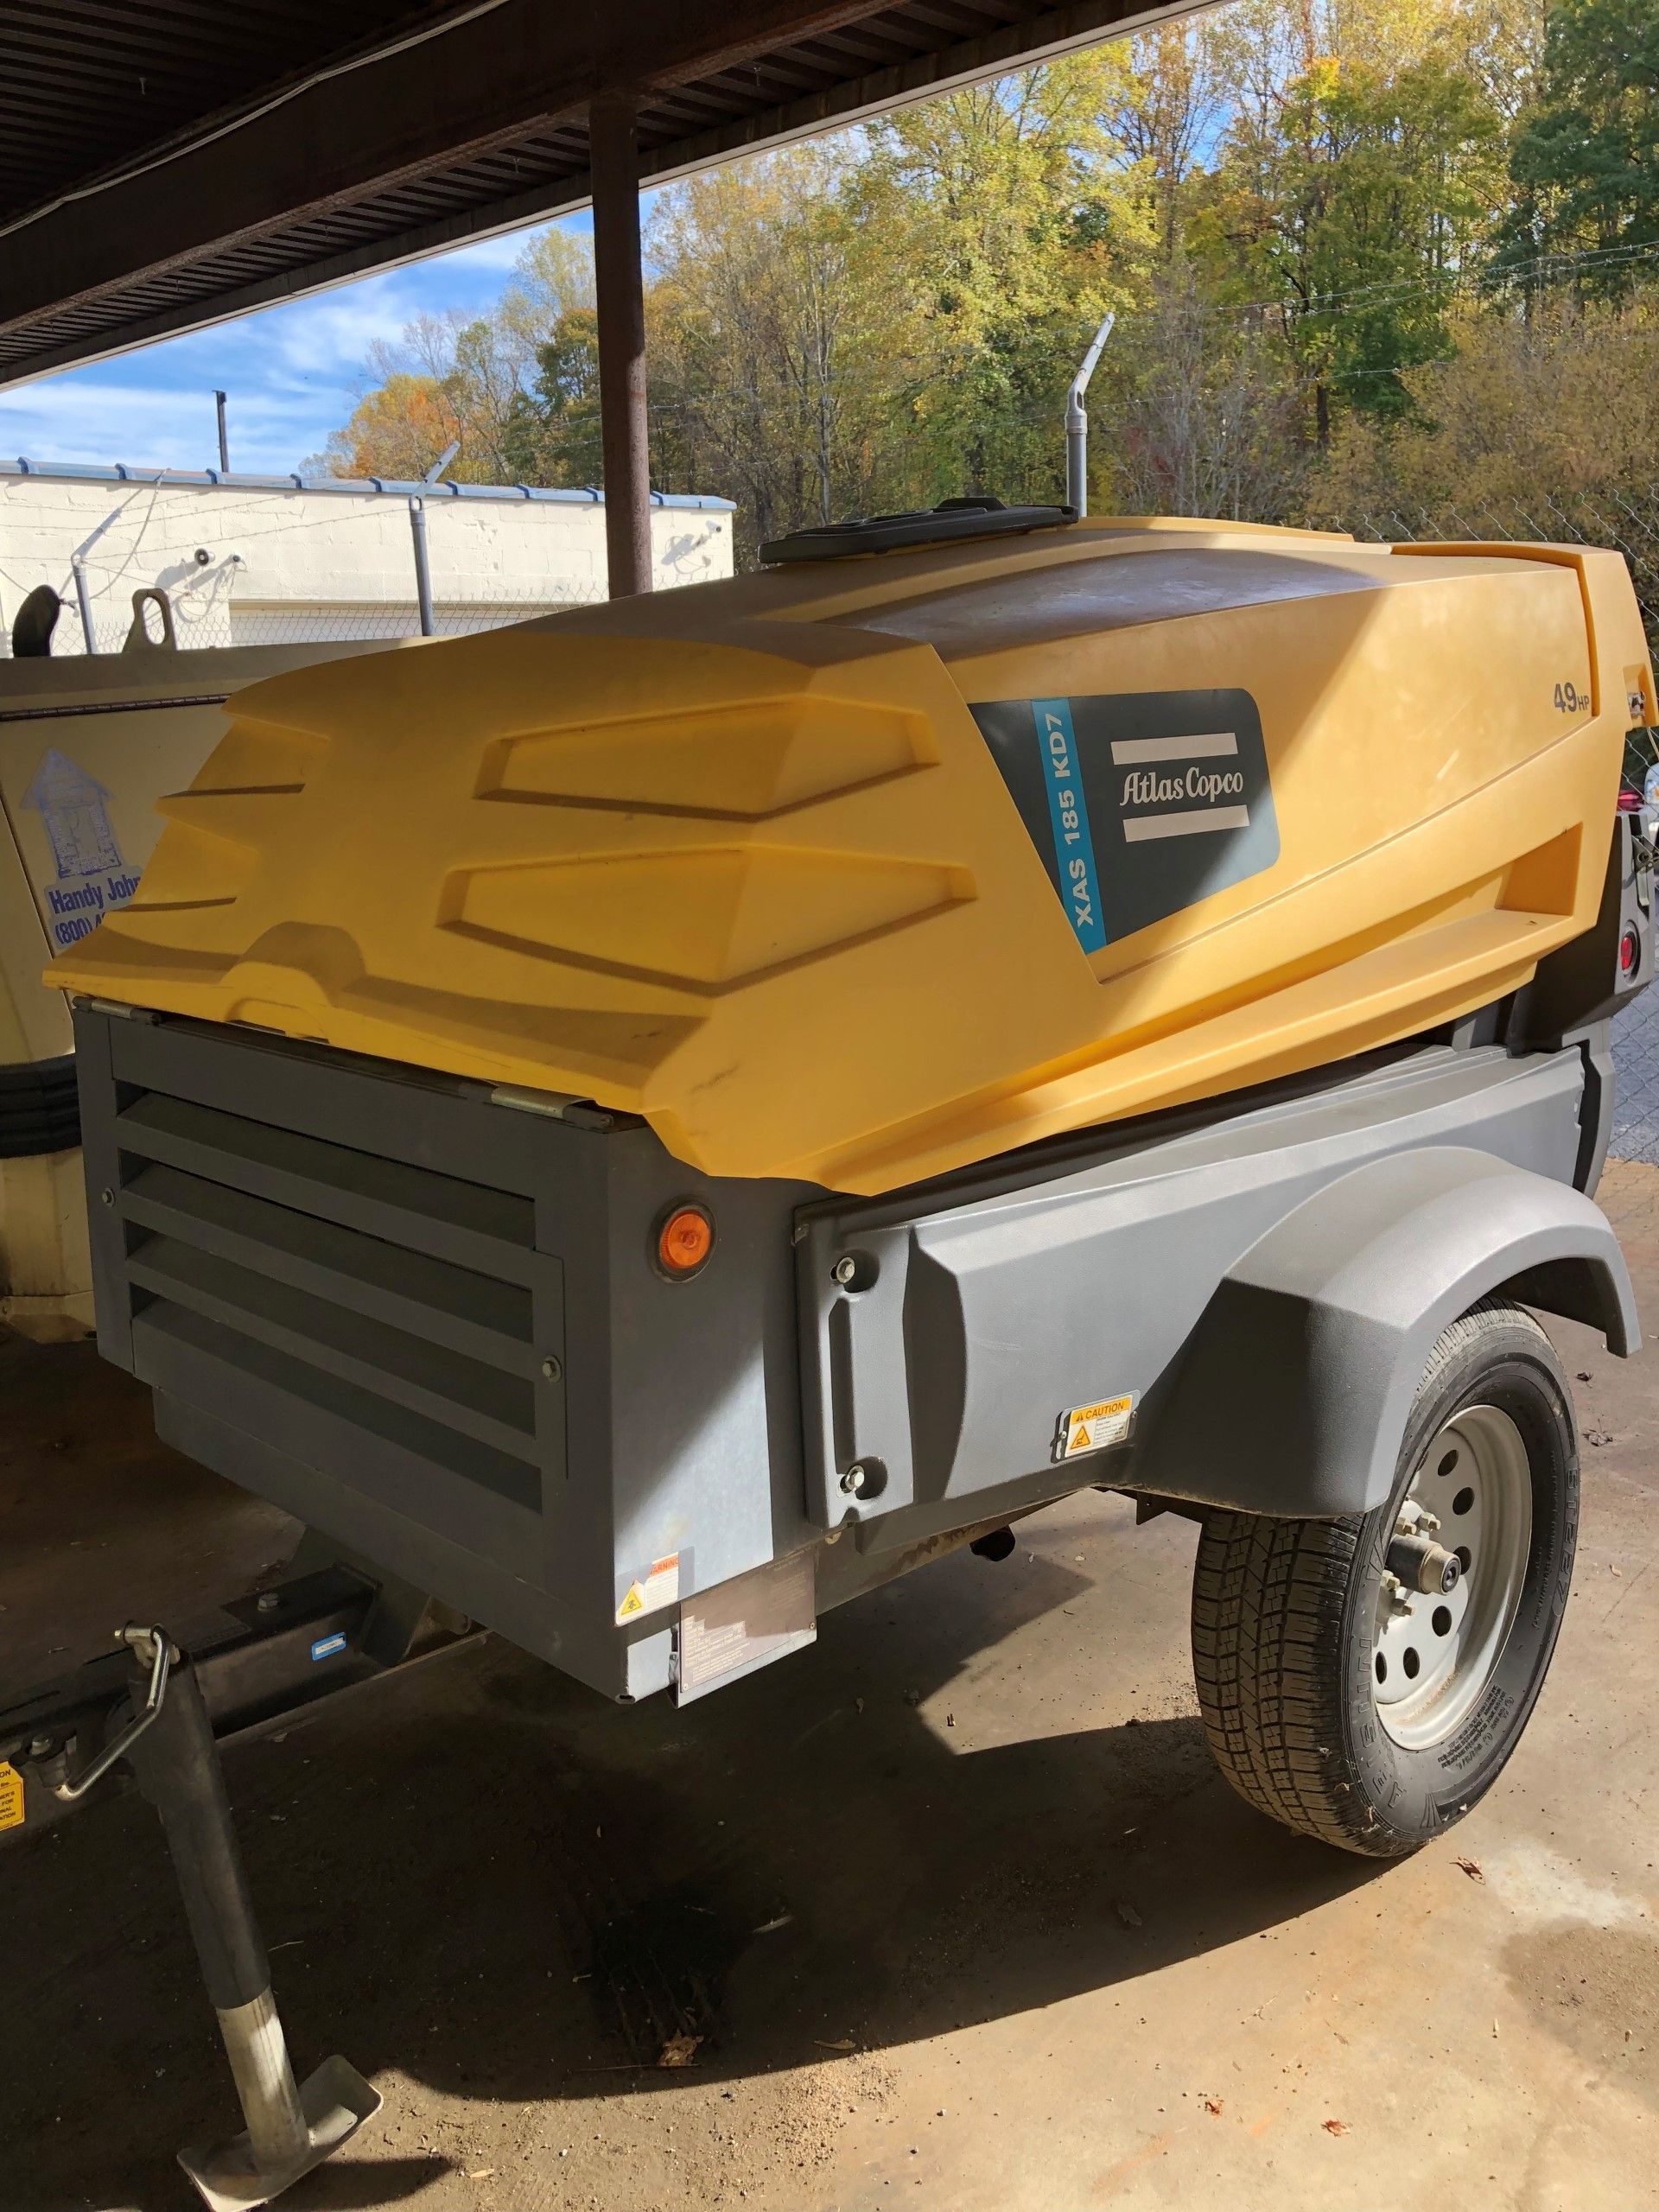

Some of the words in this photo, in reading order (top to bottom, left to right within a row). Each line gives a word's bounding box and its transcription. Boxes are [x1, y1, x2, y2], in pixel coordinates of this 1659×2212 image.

[1554, 682, 1577, 713] 49
[1045, 713, 1071, 778] KD7
[1119, 772, 1185, 806] Atlas
[1185, 766, 1243, 803] Copco
[1058, 790, 1080, 845] 185
[48, 882, 104, 914] Handy
[1068, 858, 1094, 928] XAS
[1085, 1401, 1124, 1418] CAUTION
